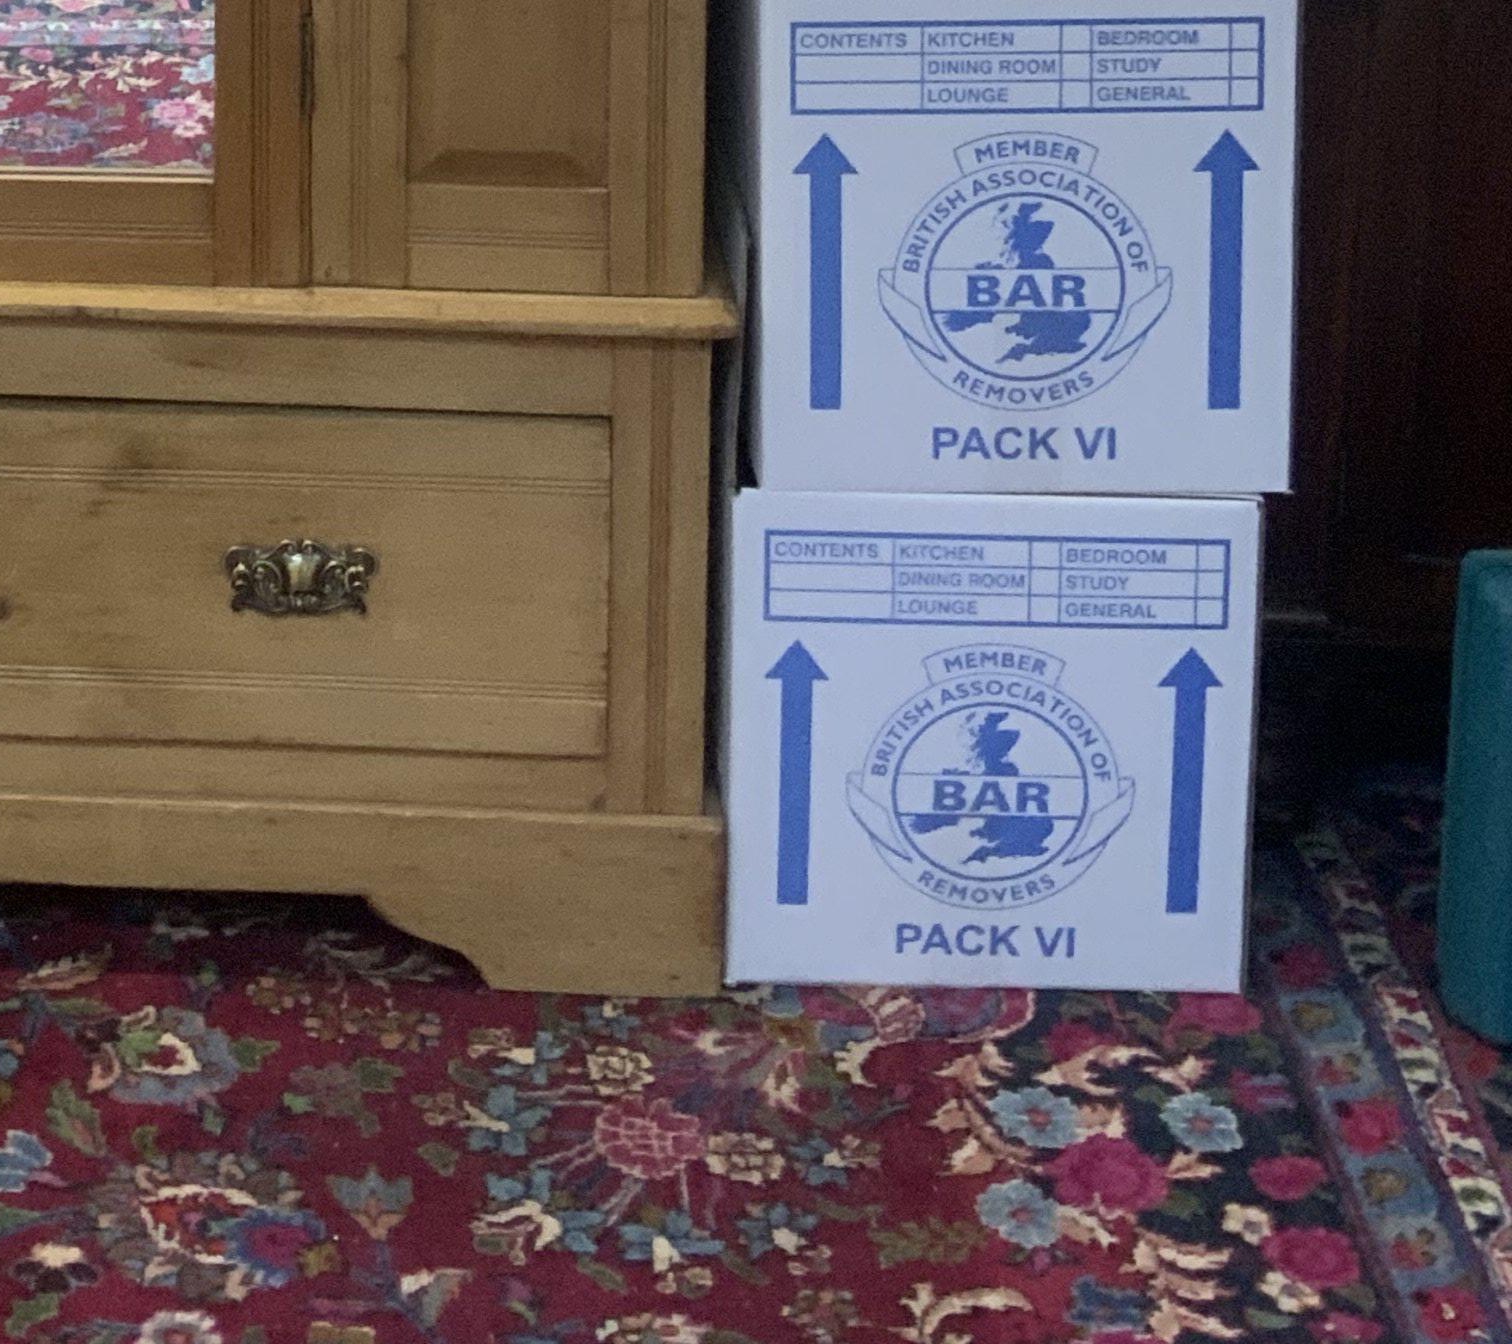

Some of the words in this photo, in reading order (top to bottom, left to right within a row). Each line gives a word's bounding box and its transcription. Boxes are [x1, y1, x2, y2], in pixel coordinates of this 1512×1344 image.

[800, 32, 907, 50] CONTENTS
[928, 31, 1014, 48] KITCHEN
[1097, 30, 1199, 46] BEDROOM
[928, 59, 993, 76] DINING
[998, 58, 1056, 75] ROOM
[1097, 58, 1162, 74] STUDY
[928, 87, 1008, 104] LOUNGE
[1097, 86, 1191, 102] GENERAL
[974, 139, 1080, 164] MEMBER
[902, 188, 967, 274] BRITISH
[971, 169, 1133, 237] ASSOCIATION
[1126, 241, 1148, 274] OF
[967, 275, 1087, 308] BAR
[952, 370, 1095, 404] REMOVERS
[931, 427, 1059, 460] PACK
[1074, 427, 1117, 460] VI
[774, 542, 879, 559] CONTENTS
[899, 544, 984, 562] KITCHEN
[1066, 548, 1167, 565] BEDROOM
[898, 570, 962, 588] DINING
[968, 572, 1026, 590] ROOM
[1066, 575, 1129, 592] STUDY
[898, 598, 978, 616] LOUNGE
[1066, 602, 1157, 619] GENERAL
[943, 651, 1048, 676] MEMBER
[871, 698, 934, 777] BRITISH
[940, 679, 1097, 747] ASSOCIATION
[1090, 752, 1111, 782] OF
[932, 779, 1050, 813] BAR
[917, 870, 1055, 904] REMOVERS
[894, 923, 1020, 957] PACK
[1034, 926, 1076, 958] VI
